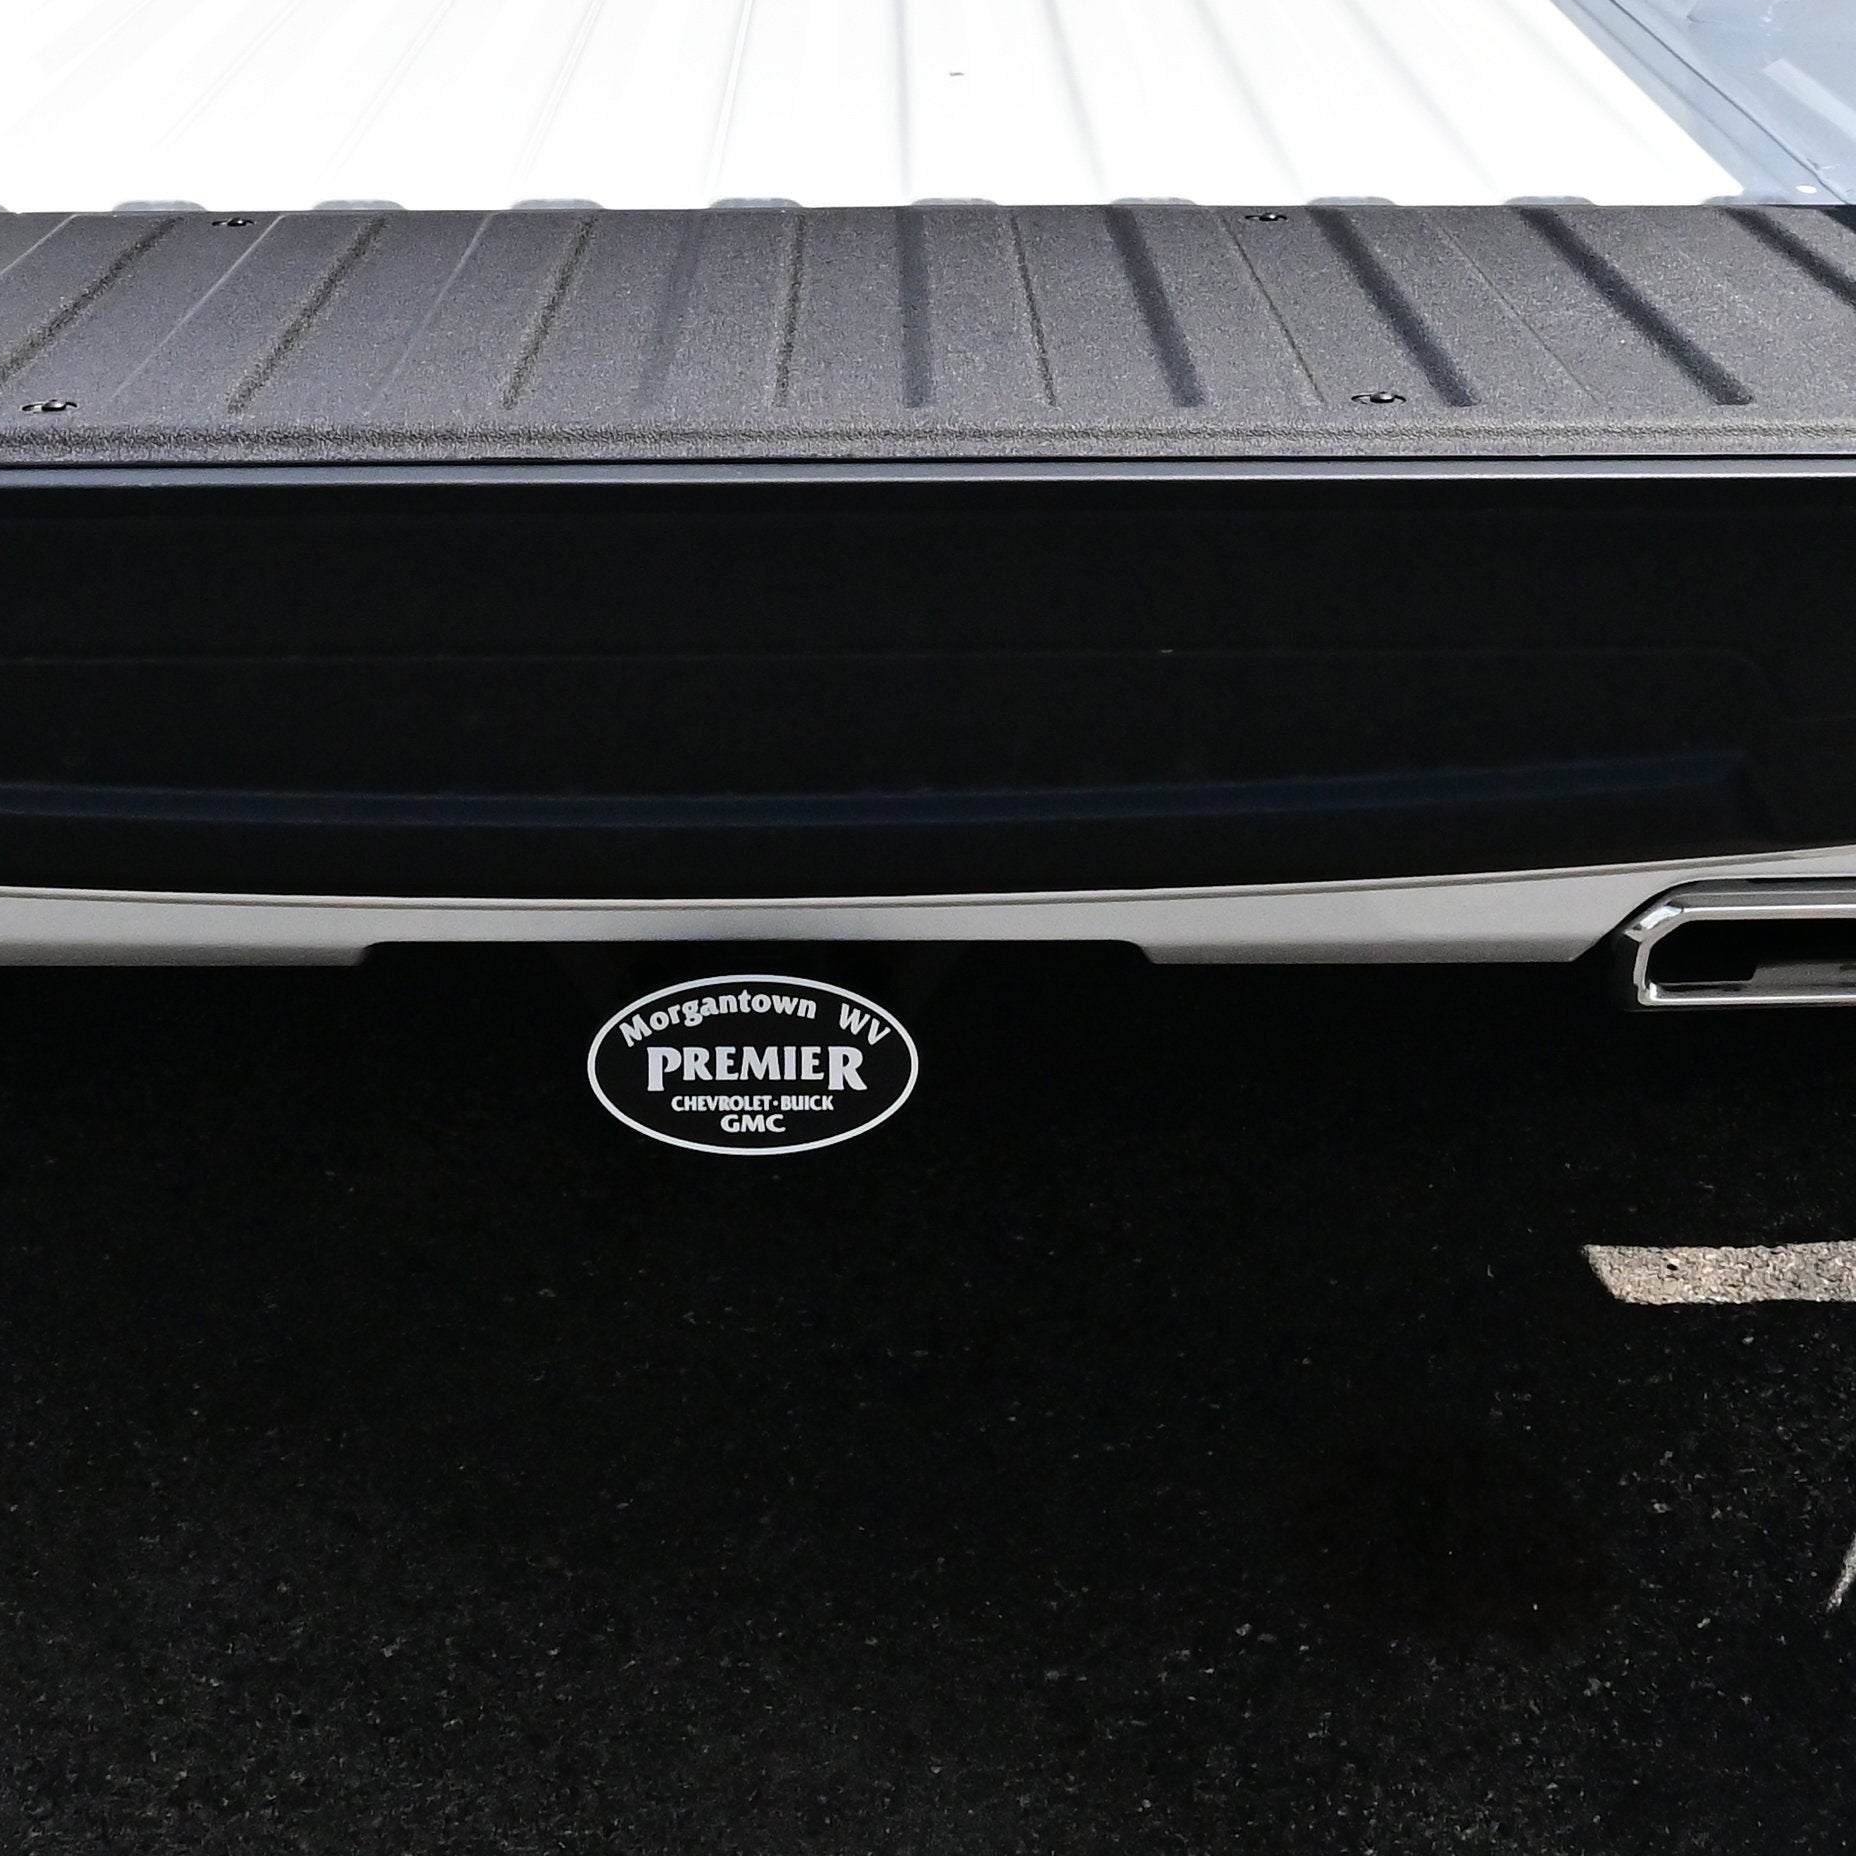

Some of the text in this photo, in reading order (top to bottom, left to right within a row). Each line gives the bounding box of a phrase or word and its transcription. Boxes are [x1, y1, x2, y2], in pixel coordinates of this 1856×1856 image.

[619, 989, 891, 1047] Morgantown WV
[647, 1046, 867, 1091] PREMIER
[720, 1114, 786, 1133] GMC
